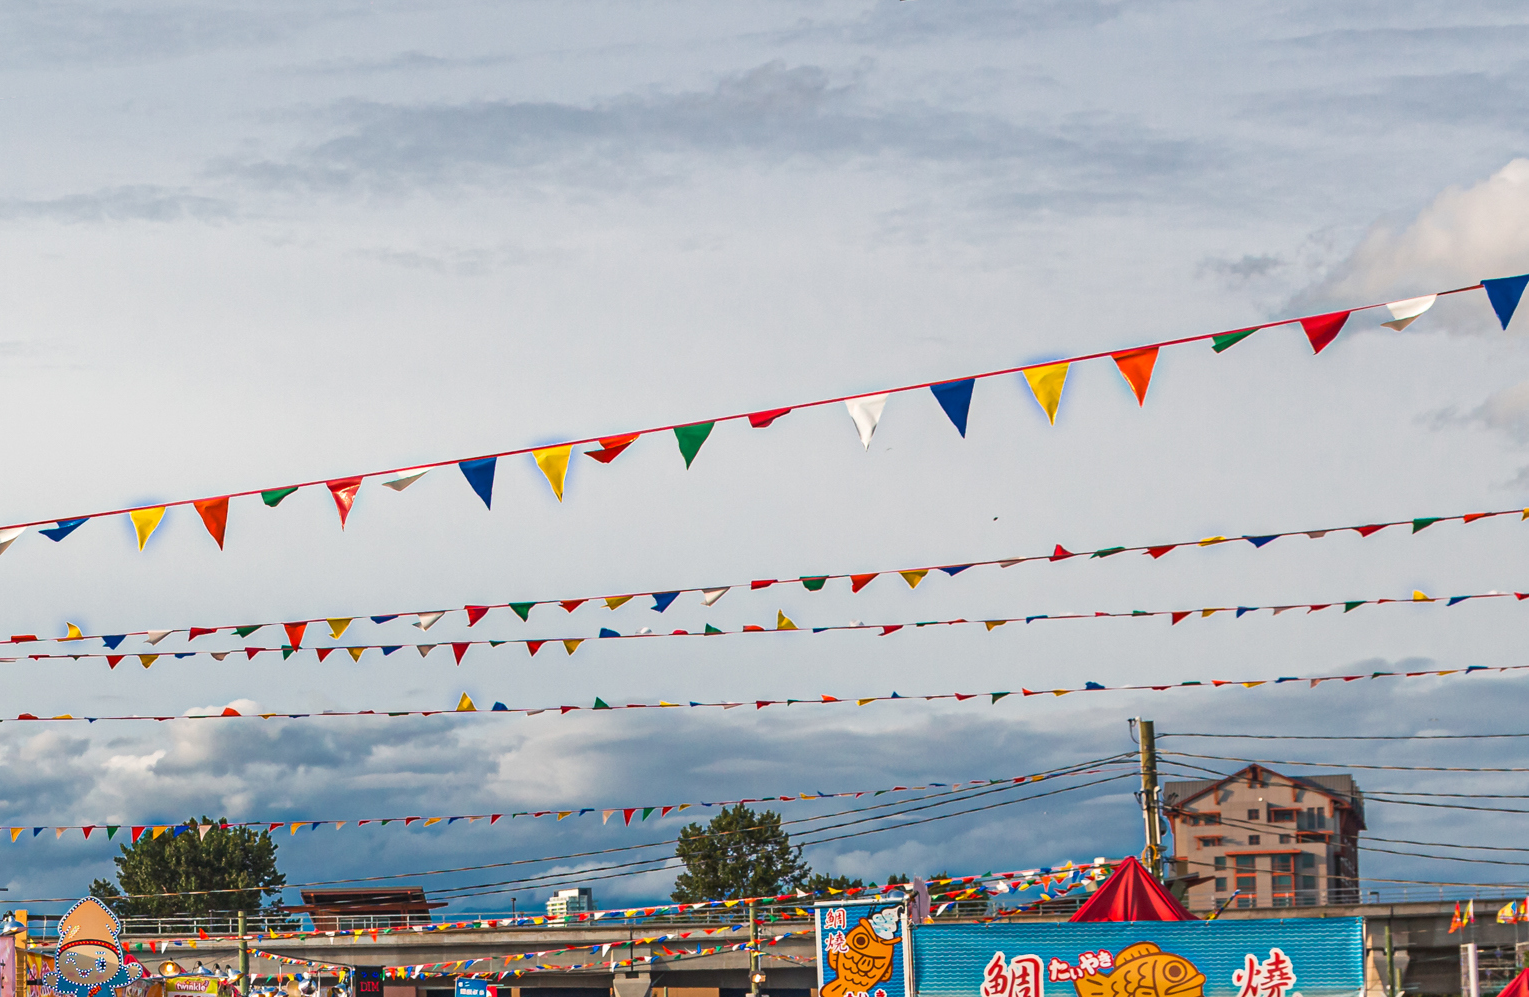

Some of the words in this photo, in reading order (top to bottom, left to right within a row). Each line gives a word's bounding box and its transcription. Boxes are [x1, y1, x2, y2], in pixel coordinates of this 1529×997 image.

[824, 908, 850, 953] 鯛燒
[1048, 949, 1114, 982] たいやき
[360, 982, 379, 992] DIM
